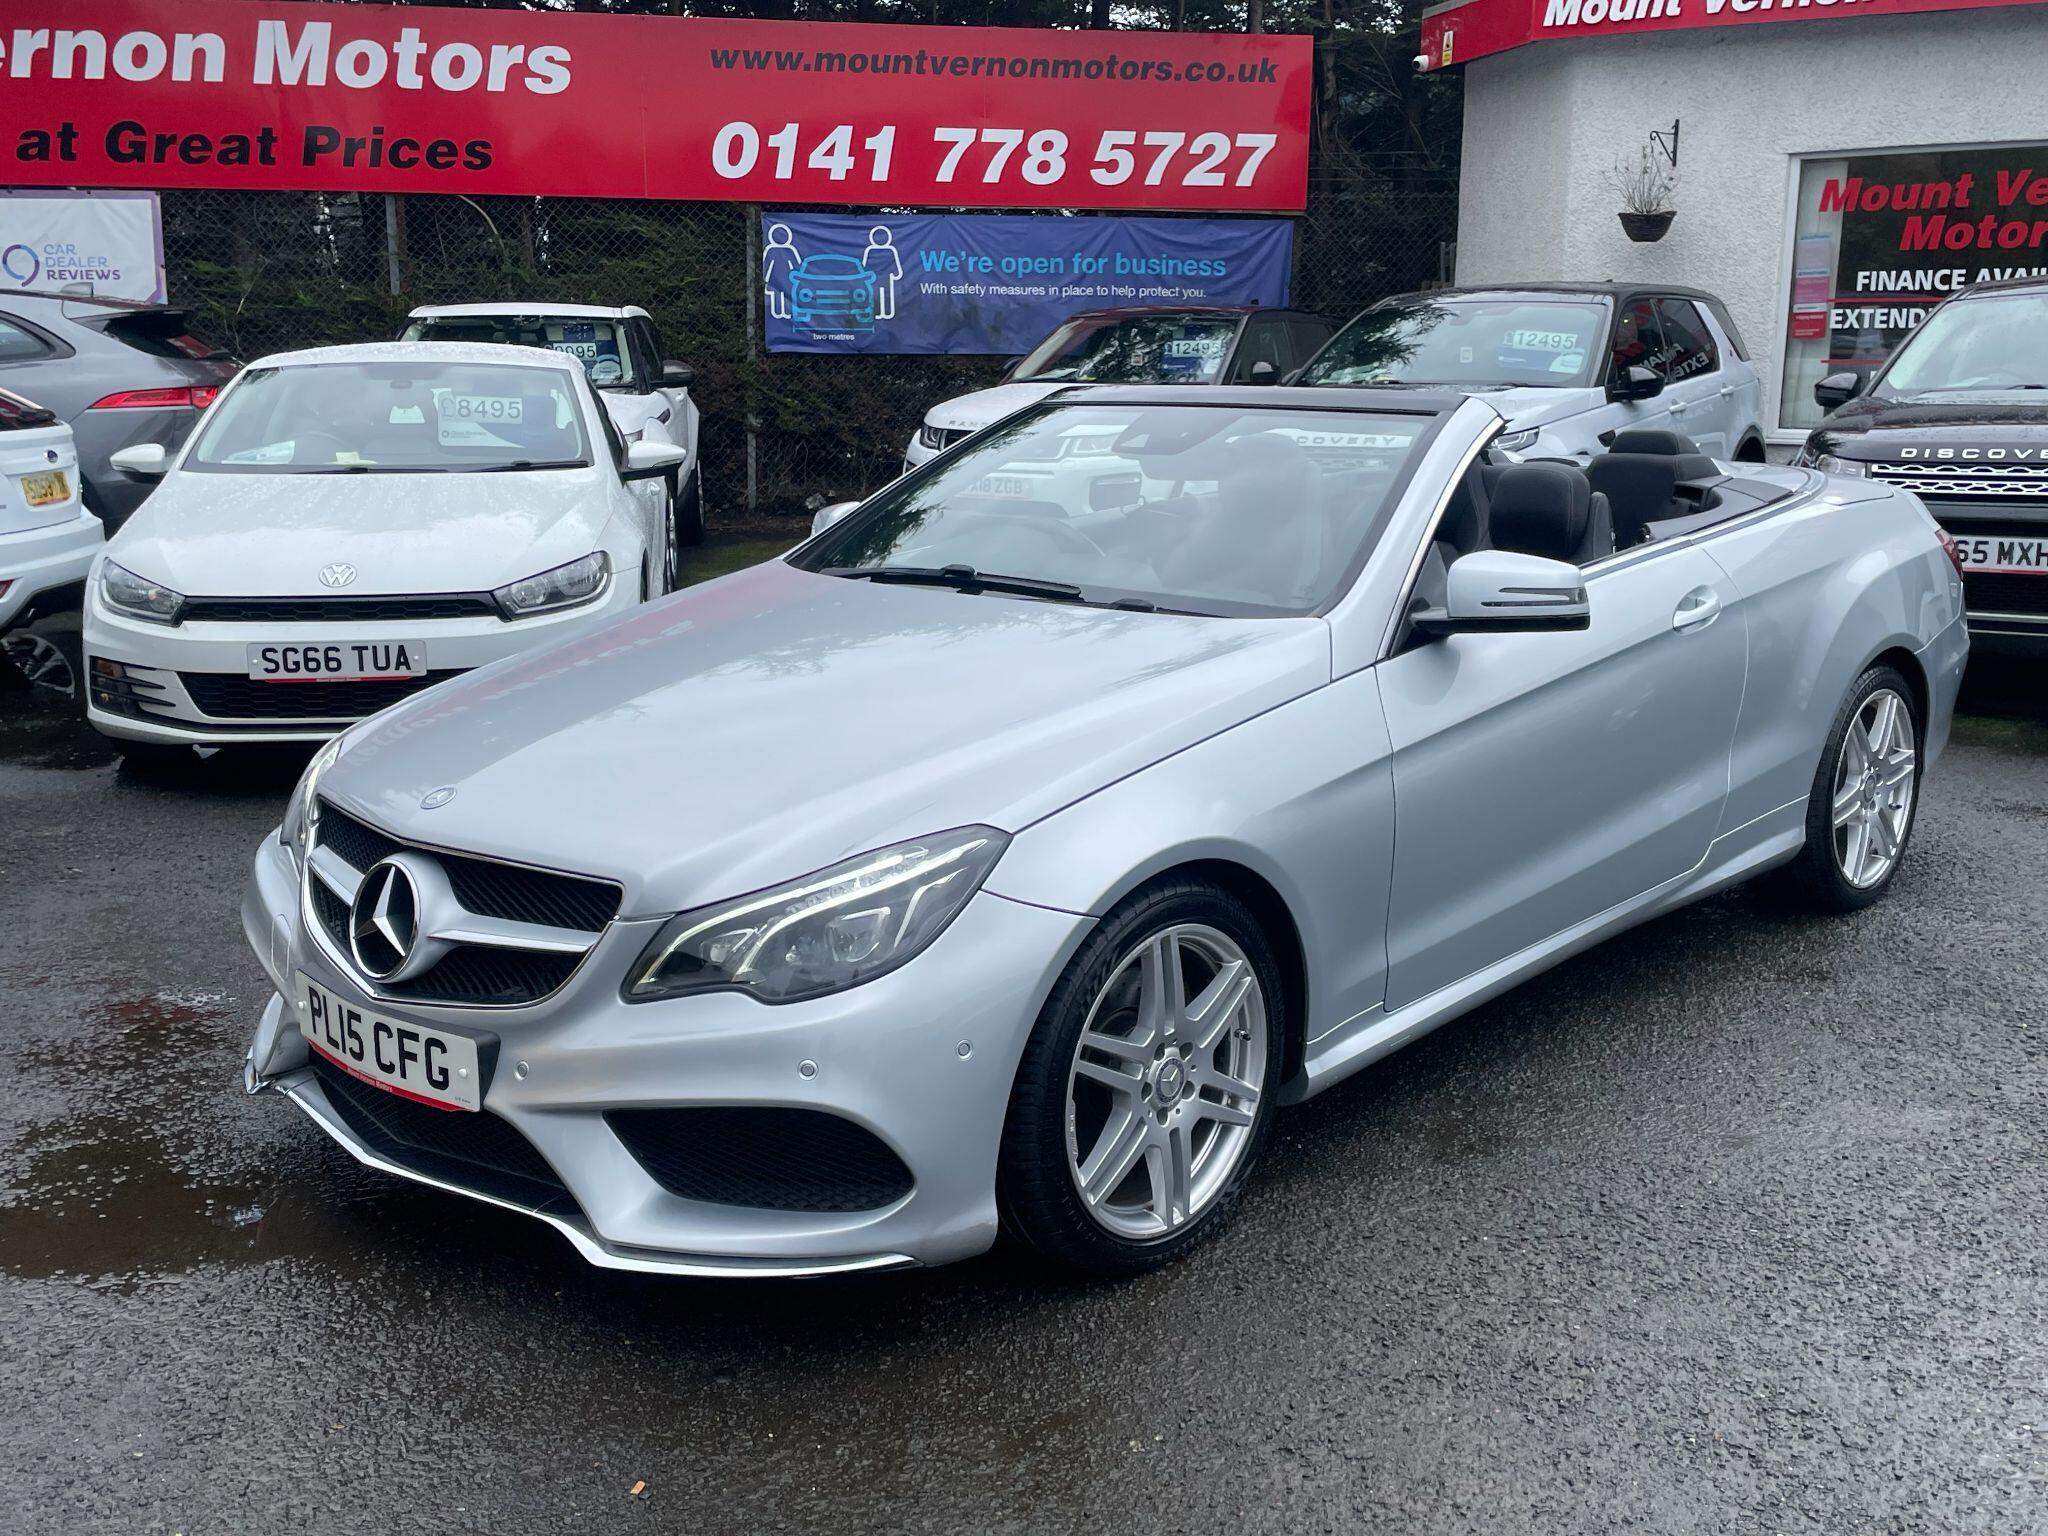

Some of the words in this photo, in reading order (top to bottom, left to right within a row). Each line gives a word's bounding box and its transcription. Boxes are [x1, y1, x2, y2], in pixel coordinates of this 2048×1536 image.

[0, 28, 226, 82] rnon
[253, 20, 572, 95] Motors
[710, 47, 1278, 84] www.mountvernonmotors.co.uk
[15, 121, 79, 162] at
[105, 120, 278, 166] Great
[302, 125, 493, 170] Prices
[711, 121, 896, 181] 0141
[933, 127, 1068, 185] 778
[1089, 131, 1277, 187] 5727
[1818, 173, 1974, 213] Mount
[43, 244, 77, 256] CAR
[45, 257, 109, 268] DEALER
[47, 269, 121, 281] REVIEWS
[920, 251, 993, 273] We’re
[1001, 255, 1064, 278] open
[1072, 252, 1108, 274] for
[1115, 253, 1227, 277] business
[920, 283, 948, 294] With
[951, 284, 986, 298] safety
[989, 286, 1045, 296] measures
[1049, 285, 1060, 296] in
[1062, 286, 1094, 298] place
[1096, 287, 1109, 296] to
[1111, 286, 1136, 299] help
[1139, 287, 1179, 299] protect
[1182, 289, 1206, 298] you.
[1856, 269, 1967, 292] FINANCE
[1829, 308, 1934, 329] EXTEND
[261, 646, 342, 674] SG66
[351, 645, 411, 672] TUA
[308, 985, 365, 1063] PL15
[373, 1021, 450, 1091] CFG
